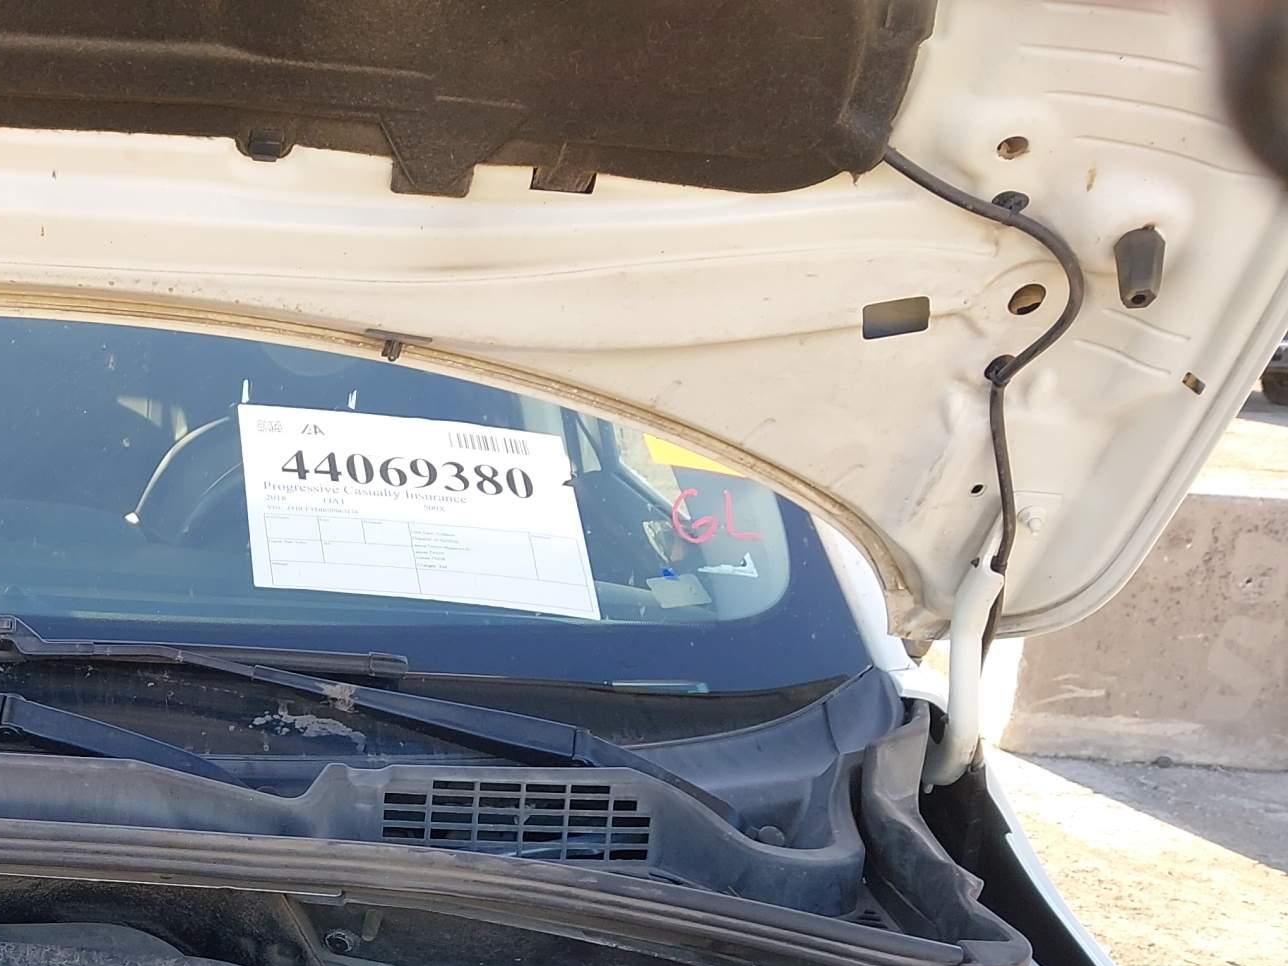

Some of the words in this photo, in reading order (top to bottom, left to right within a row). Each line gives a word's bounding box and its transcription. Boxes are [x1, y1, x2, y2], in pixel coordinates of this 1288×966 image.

[263, 481, 341, 496] Progressive
[343, 486, 401, 500] Casualty
[404, 490, 468, 504] Insurance
[281, 449, 534, 499] 44069380
[672, 487, 764, 544] GL
